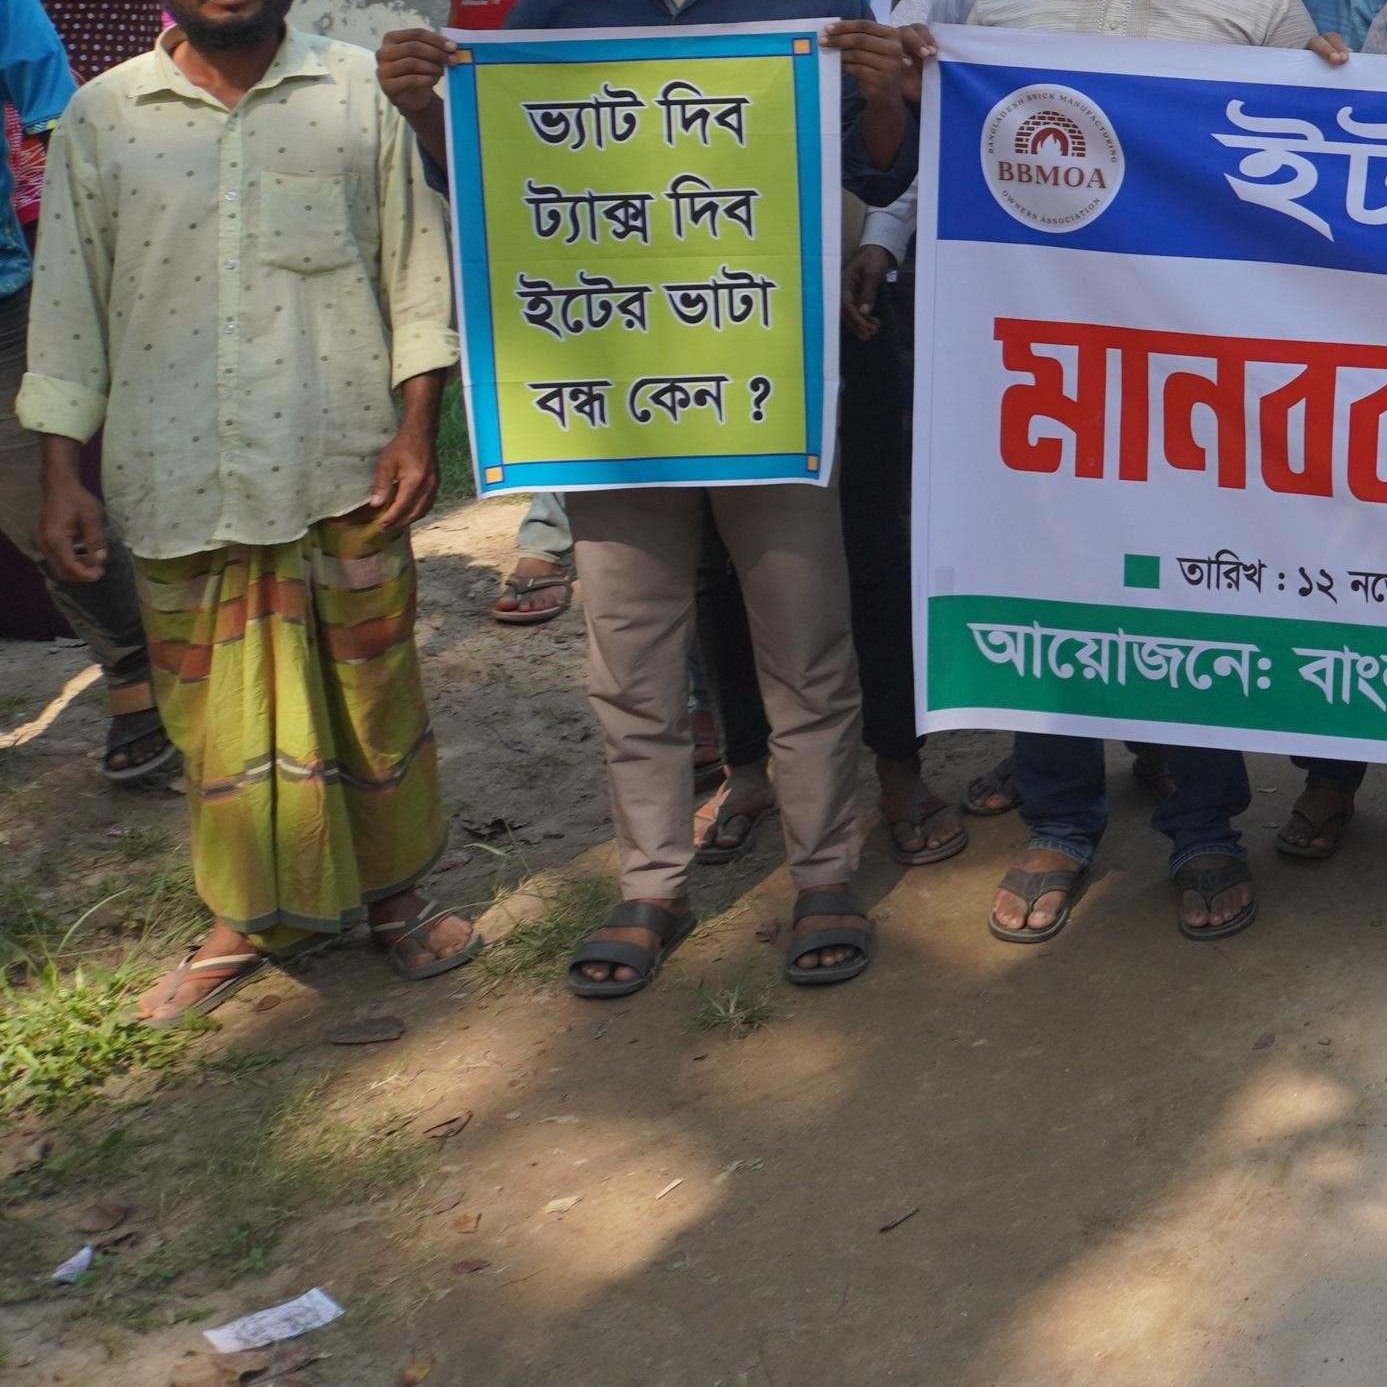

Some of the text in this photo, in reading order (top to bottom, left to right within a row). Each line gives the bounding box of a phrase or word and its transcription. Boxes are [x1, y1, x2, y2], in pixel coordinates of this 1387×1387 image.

[520, 79, 751, 152] ভ্যাট দিব
[1026, 92, 1056, 102] BRICK
[998, 160, 1107, 189] BBMOA
[522, 174, 760, 246] ট্যাক্স দিব
[1002, 189, 1101, 224] OWNERS ASSOCIATION
[514, 264, 780, 341] ইটের ভাটা
[527, 374, 772, 431] বন্ধ কেন ?
[1176, 548, 1268, 591] তারিখ
[1298, 566, 1338, 604] ১২
[967, 619, 1274, 695] আয়োজনে:
